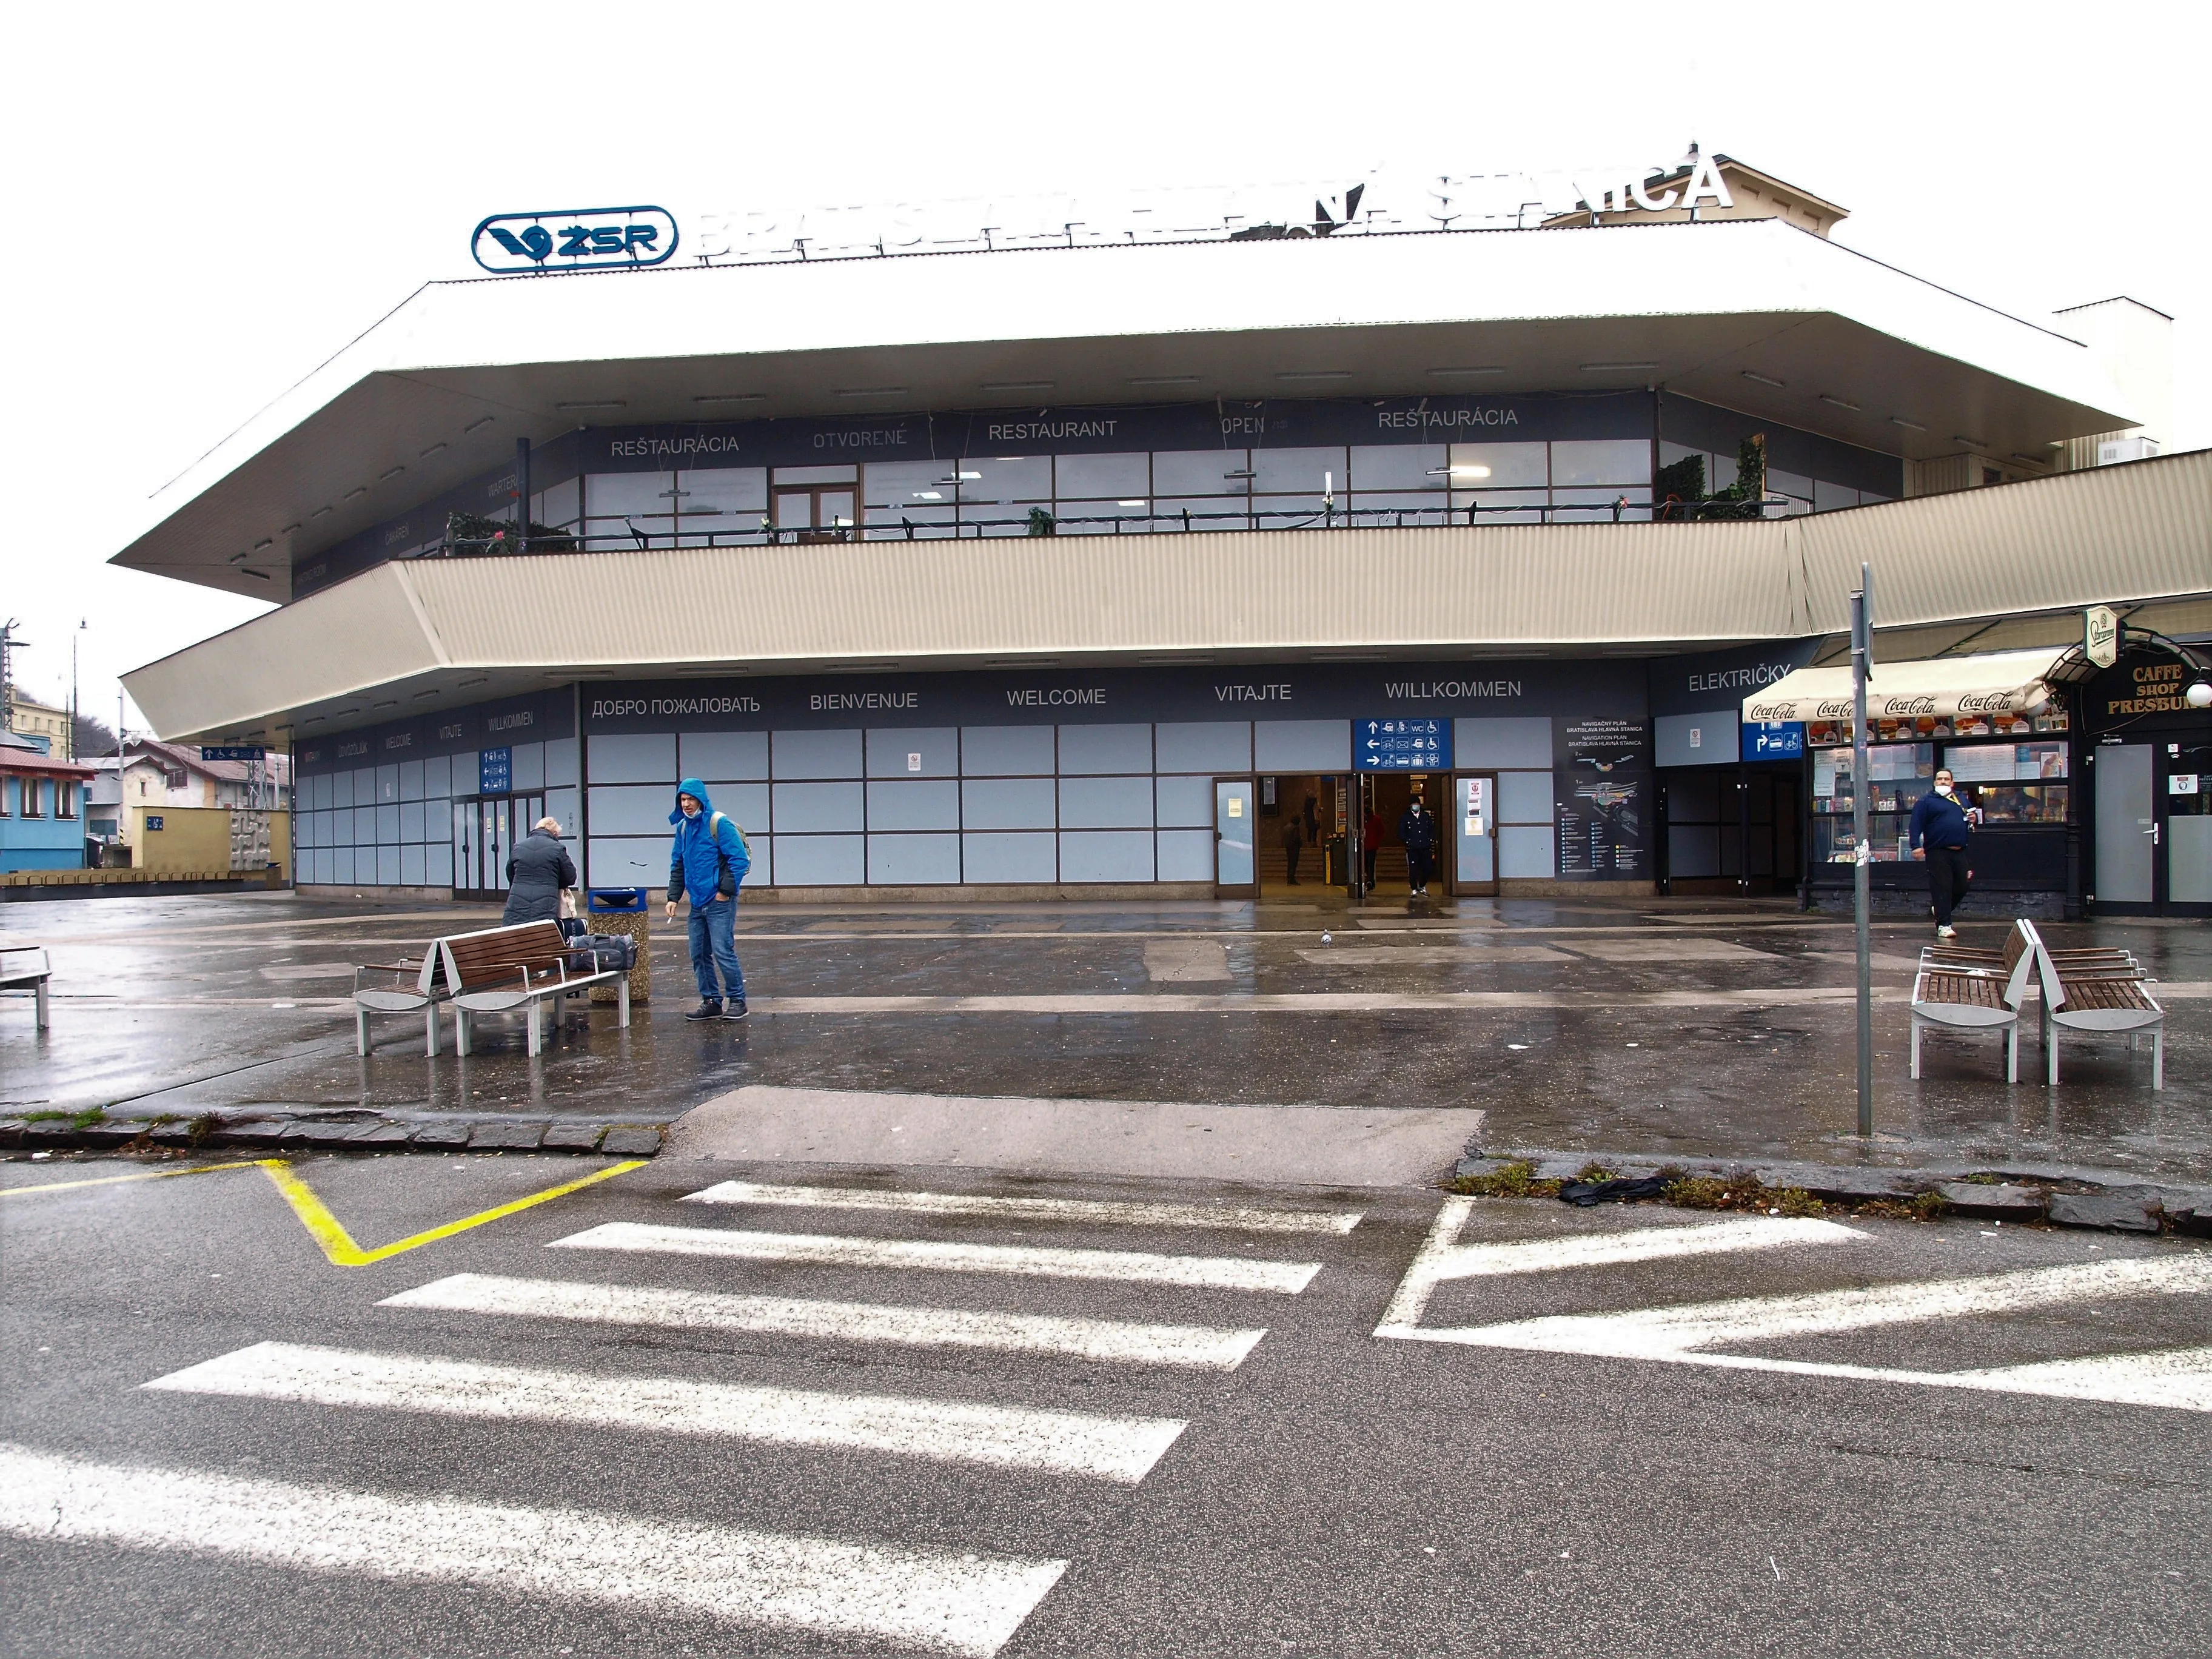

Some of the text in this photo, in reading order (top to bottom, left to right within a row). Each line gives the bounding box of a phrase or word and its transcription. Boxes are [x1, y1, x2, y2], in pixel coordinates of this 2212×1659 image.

[1428, 156, 1734, 220] SNICA
[1222, 417, 1264, 434] OPEN
[1378, 407, 1518, 428] REŠTAURÁCIA
[813, 422, 907, 448] OTVORENÉ
[988, 420, 1118, 440] RESTAURANT
[611, 434, 740, 457] REŠTAURÁCIA
[488, 474, 517, 498] WARTER
[1689, 663, 1791, 692] ELEKTRIČKY
[2133, 664, 2183, 682] CAFFE
[1007, 688, 1107, 706] WELCOME
[1215, 684, 1292, 702] VITAJTE
[1385, 680, 1521, 699] WILLKOMMEN
[2136, 683, 2179, 696] SHOP
[592, 696, 760, 718] ДОБРО ПОЖАЛОВАТЬ
[811, 692, 918, 710] BIENVENUE
[1817, 700, 1854, 718] Coca-Co
[1885, 696, 1938, 715] Coca-Cola
[1958, 691, 2014, 712] Coca-Cola
[1751, 703, 1798, 720] Coca-Cola
[488, 711, 534, 732] WILLKOMMEN
[386, 733, 411, 749] WELCOME
[438, 723, 463, 740] VITAJTE
